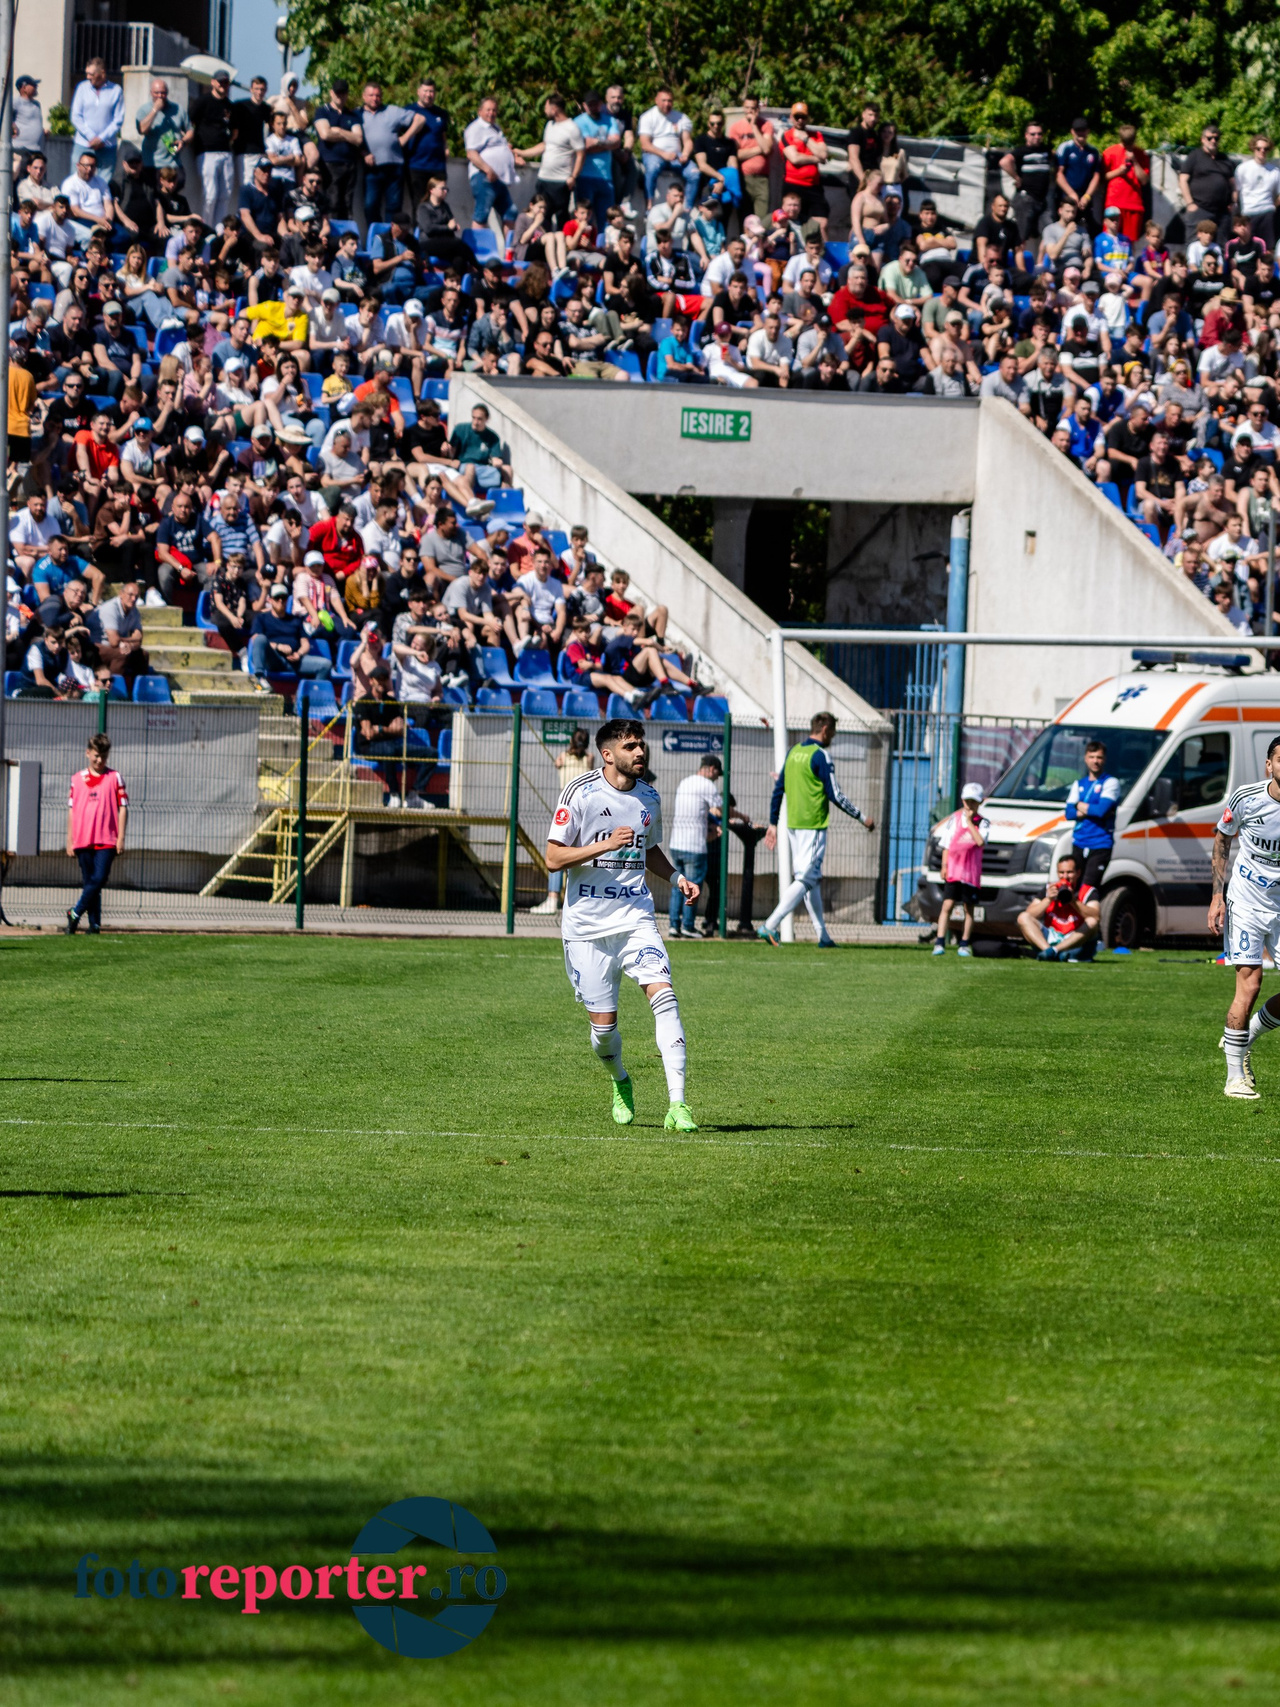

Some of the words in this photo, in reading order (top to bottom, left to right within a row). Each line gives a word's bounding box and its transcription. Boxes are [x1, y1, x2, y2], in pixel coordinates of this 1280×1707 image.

[682, 410, 734, 436] IESIRE
[739, 415, 750, 437] 2
[180, 652, 191, 667] 3
[578, 883, 650, 900] ELSACO
[1239, 930, 1251, 951] 8
